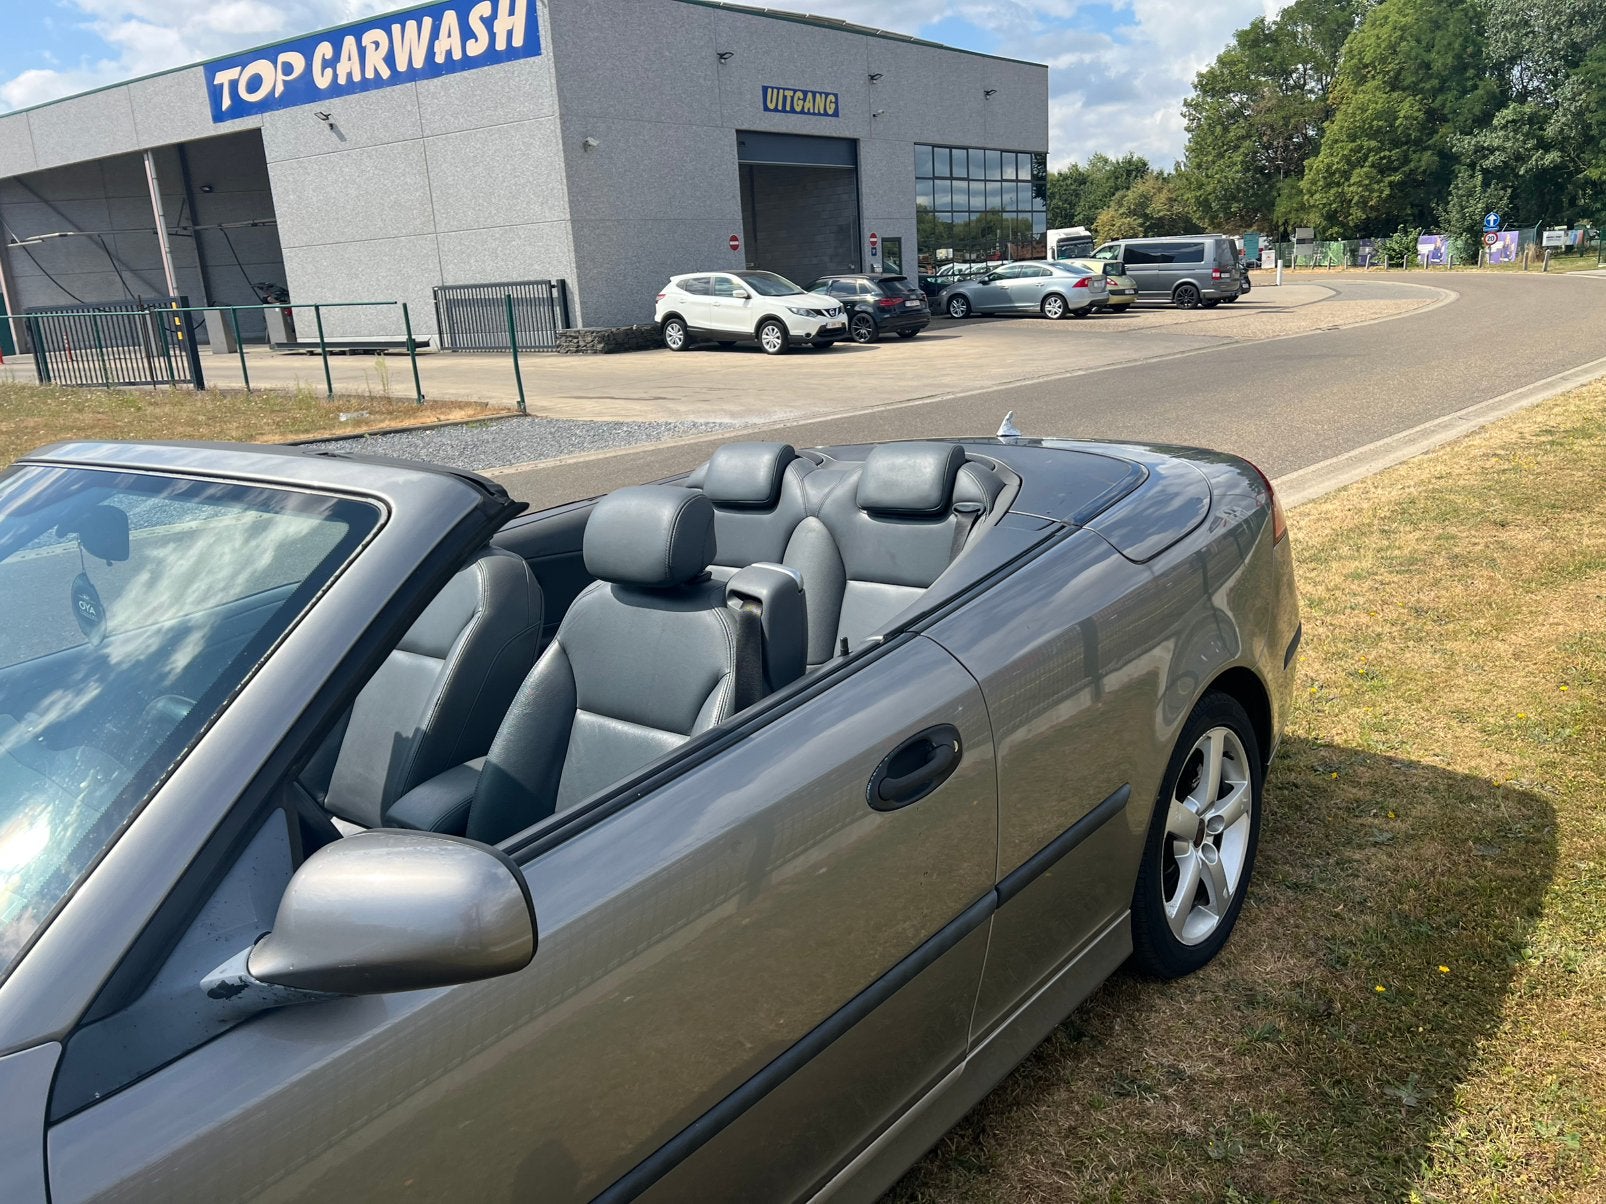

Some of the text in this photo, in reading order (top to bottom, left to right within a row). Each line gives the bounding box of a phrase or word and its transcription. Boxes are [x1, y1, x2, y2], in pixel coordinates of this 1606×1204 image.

[213, 0, 528, 111] TOP CARWASH
[766, 87, 836, 115] UITGANG
[79, 601, 96, 615] OYA
